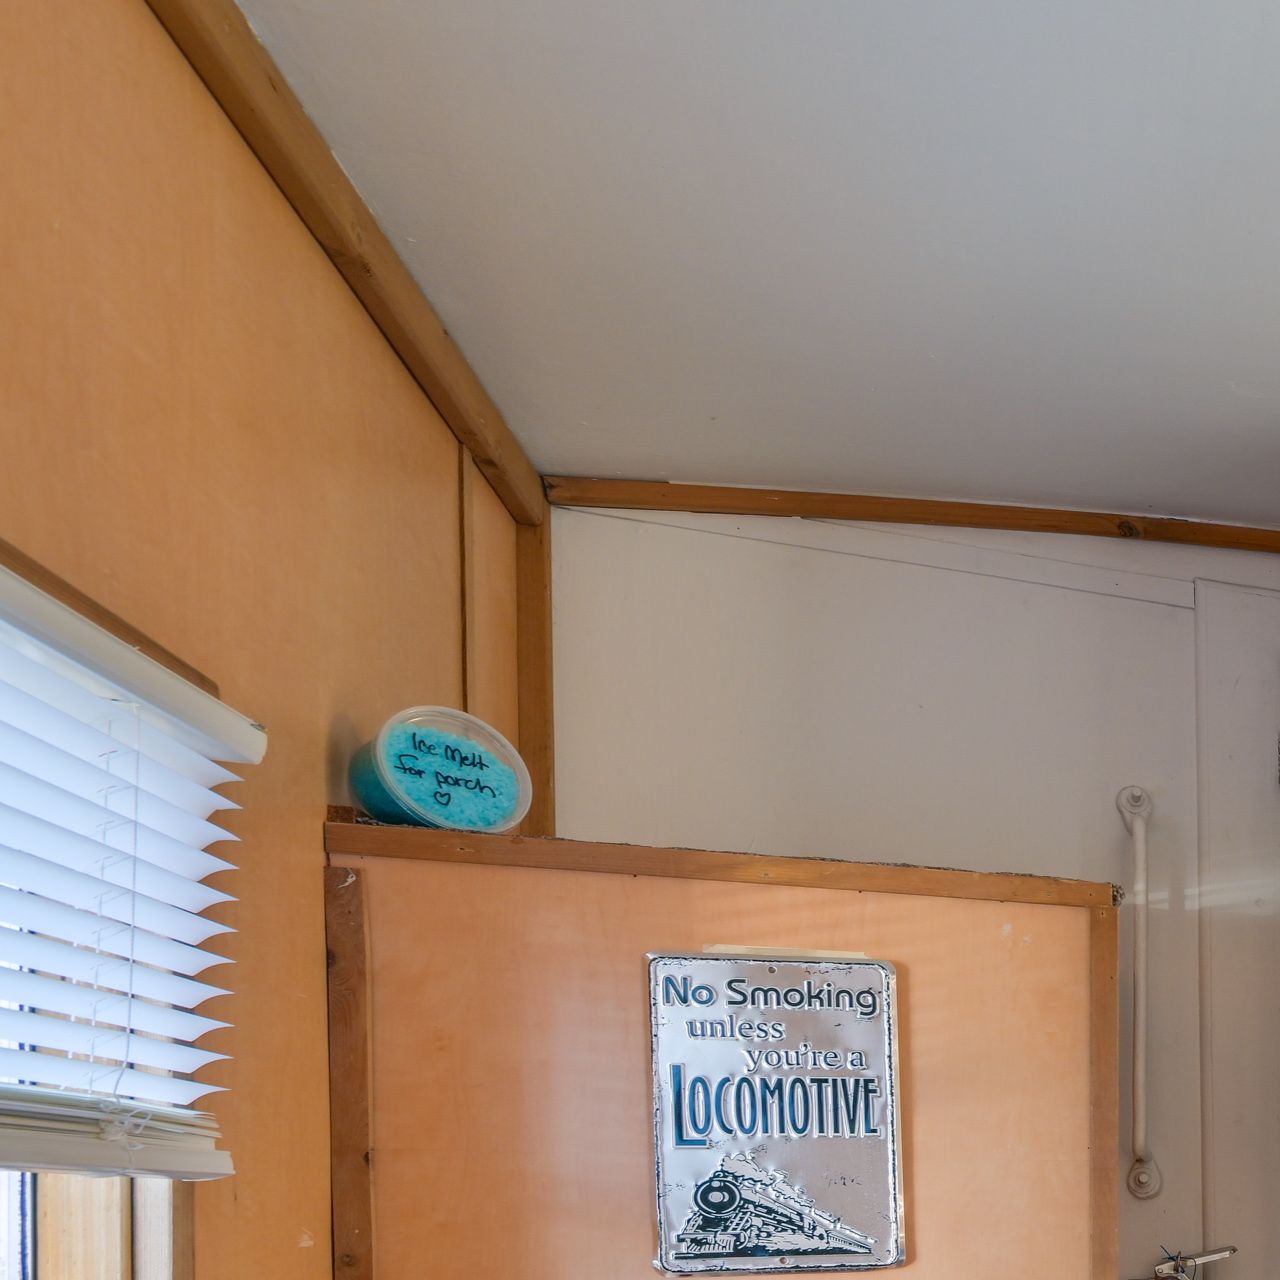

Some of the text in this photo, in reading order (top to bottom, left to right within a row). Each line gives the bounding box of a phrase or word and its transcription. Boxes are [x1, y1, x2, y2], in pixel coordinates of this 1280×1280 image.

[412, 732, 489, 771] Ice Melt
[662, 975, 878, 1016] No Smoking
[686, 1014, 785, 1041] unless
[744, 1042, 867, 1072] you're a
[669, 1063, 880, 1147] LOCOMOTIVE
